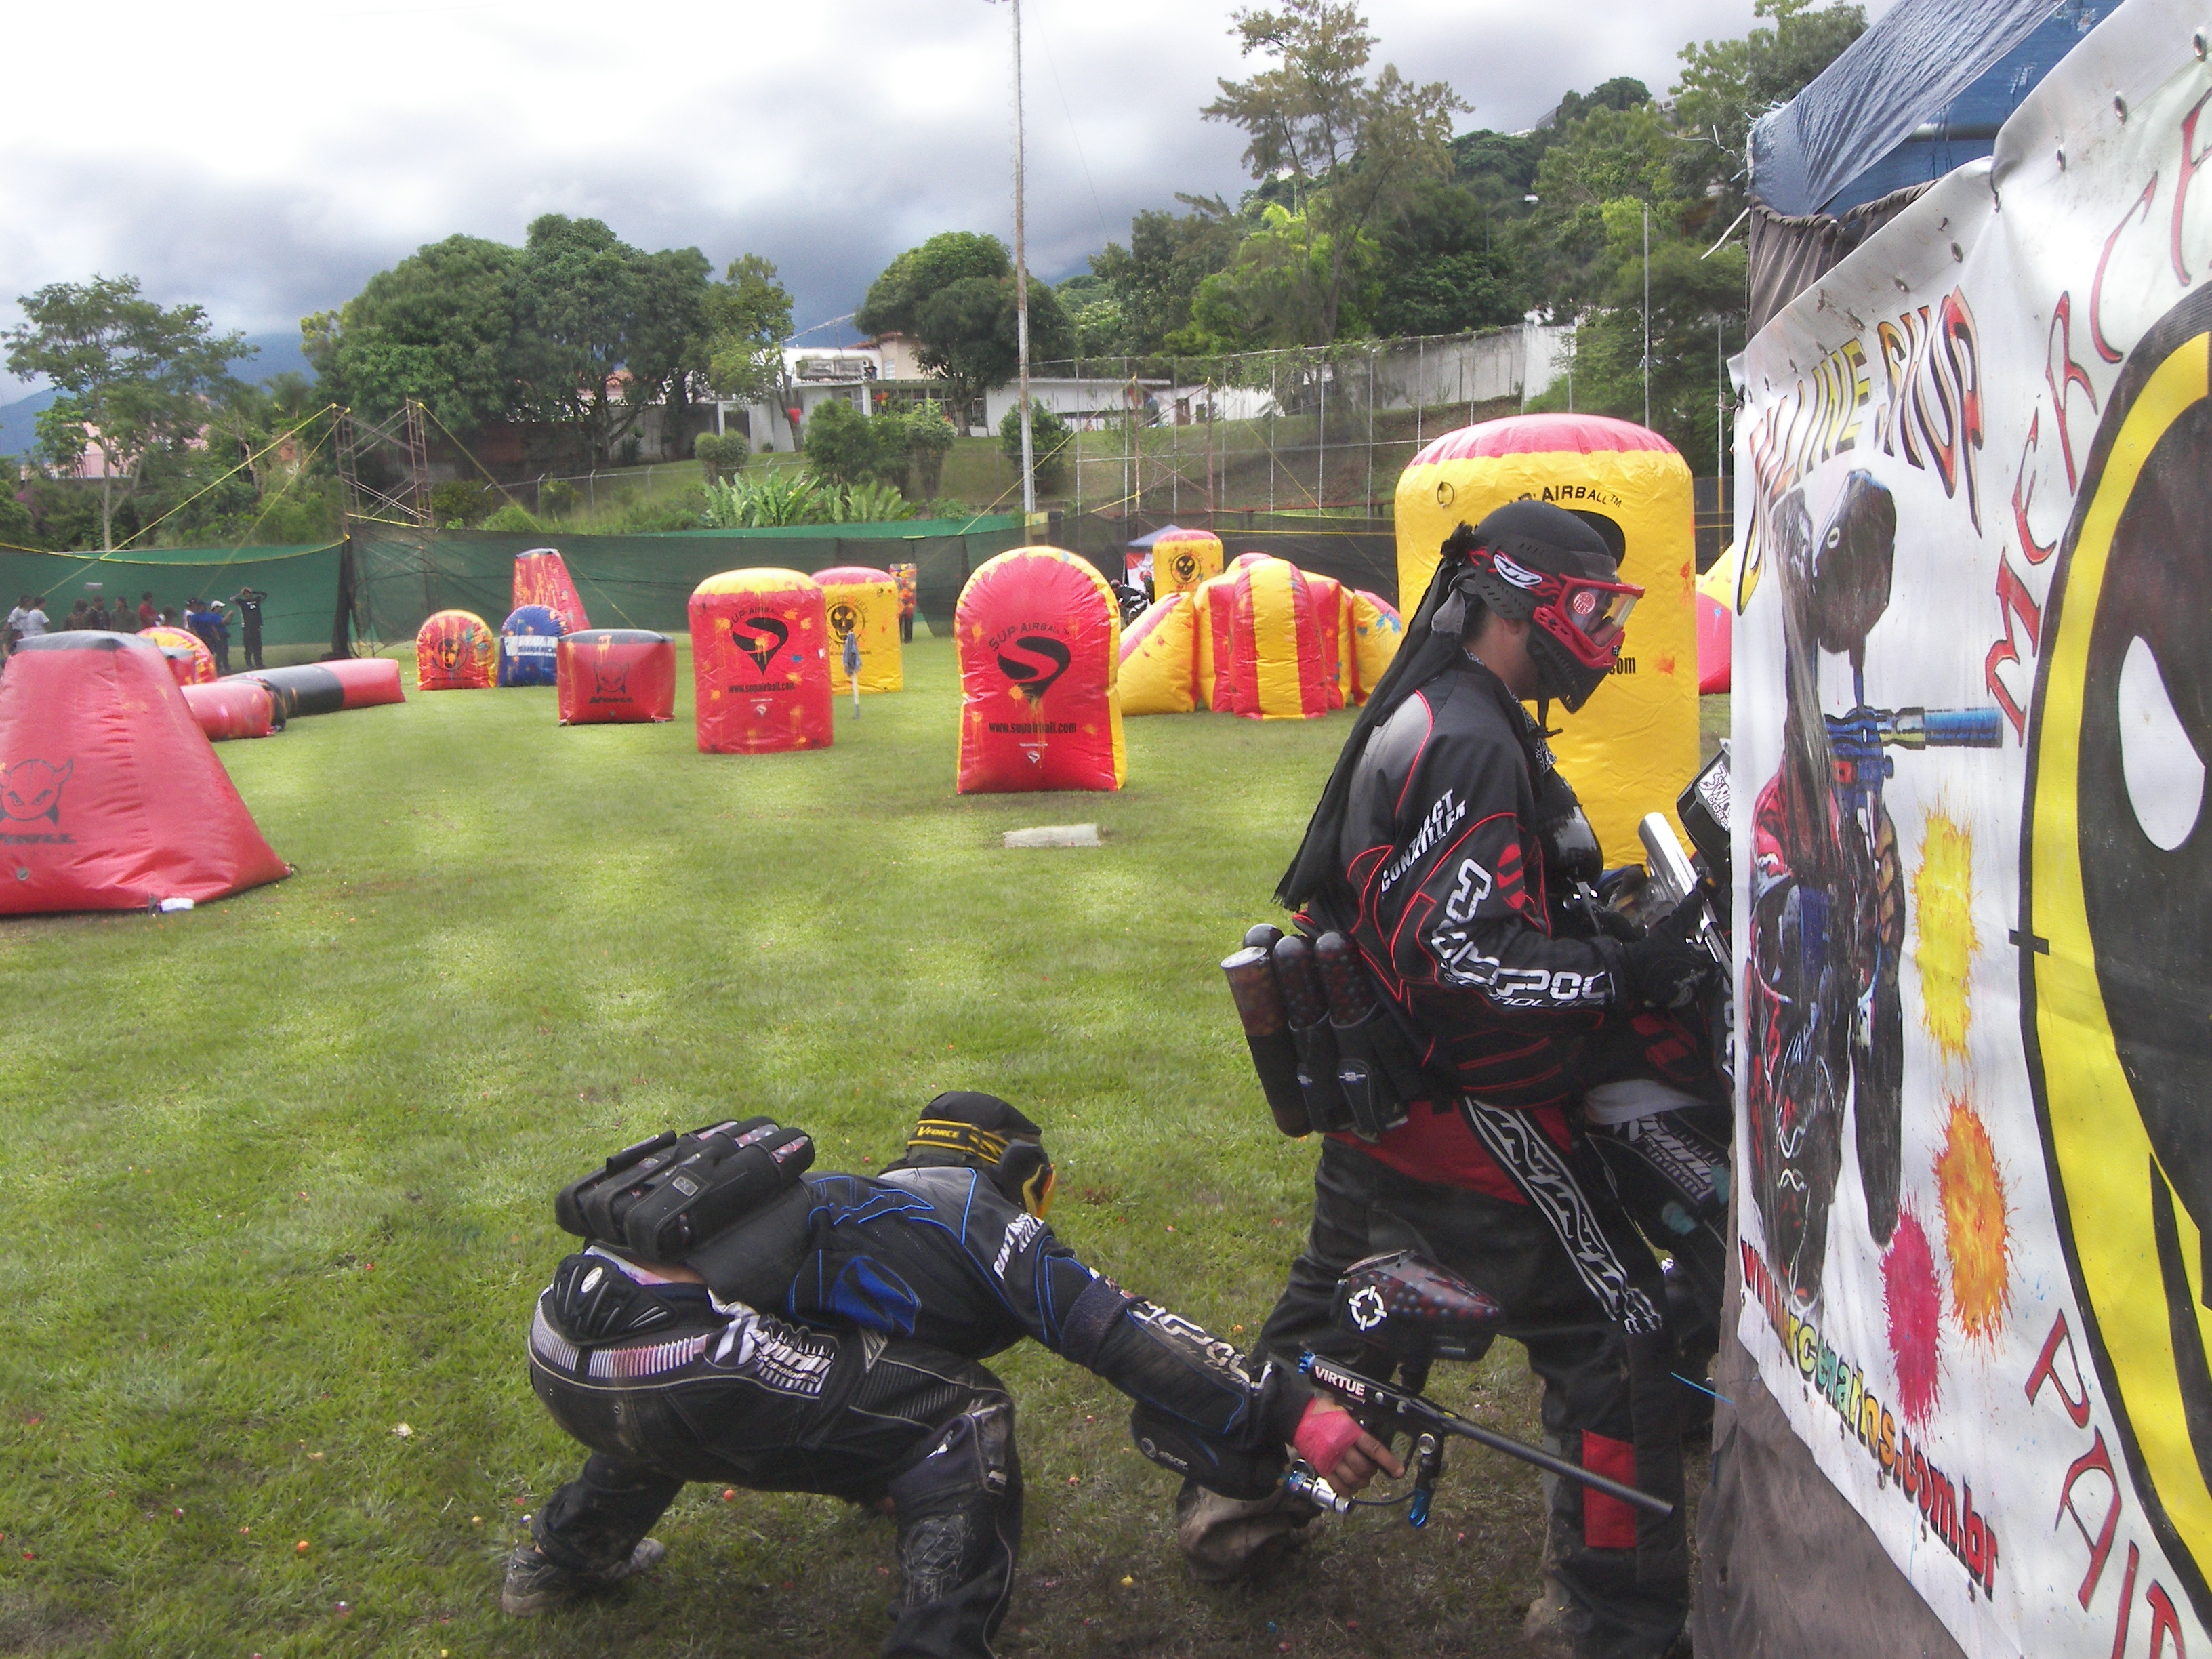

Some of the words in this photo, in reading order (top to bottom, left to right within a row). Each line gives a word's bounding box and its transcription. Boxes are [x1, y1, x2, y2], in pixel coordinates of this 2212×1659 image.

[1875, 285, 1984, 539] SHOP
[1542, 485, 1607, 505] AIRBALL
[989, 626, 1017, 652] SUP
[1021, 622, 1059, 635] AIRBALL
[989, 722, 1077, 734] www.supairball.com
[1315, 1365, 1366, 1397] VIRTUE
